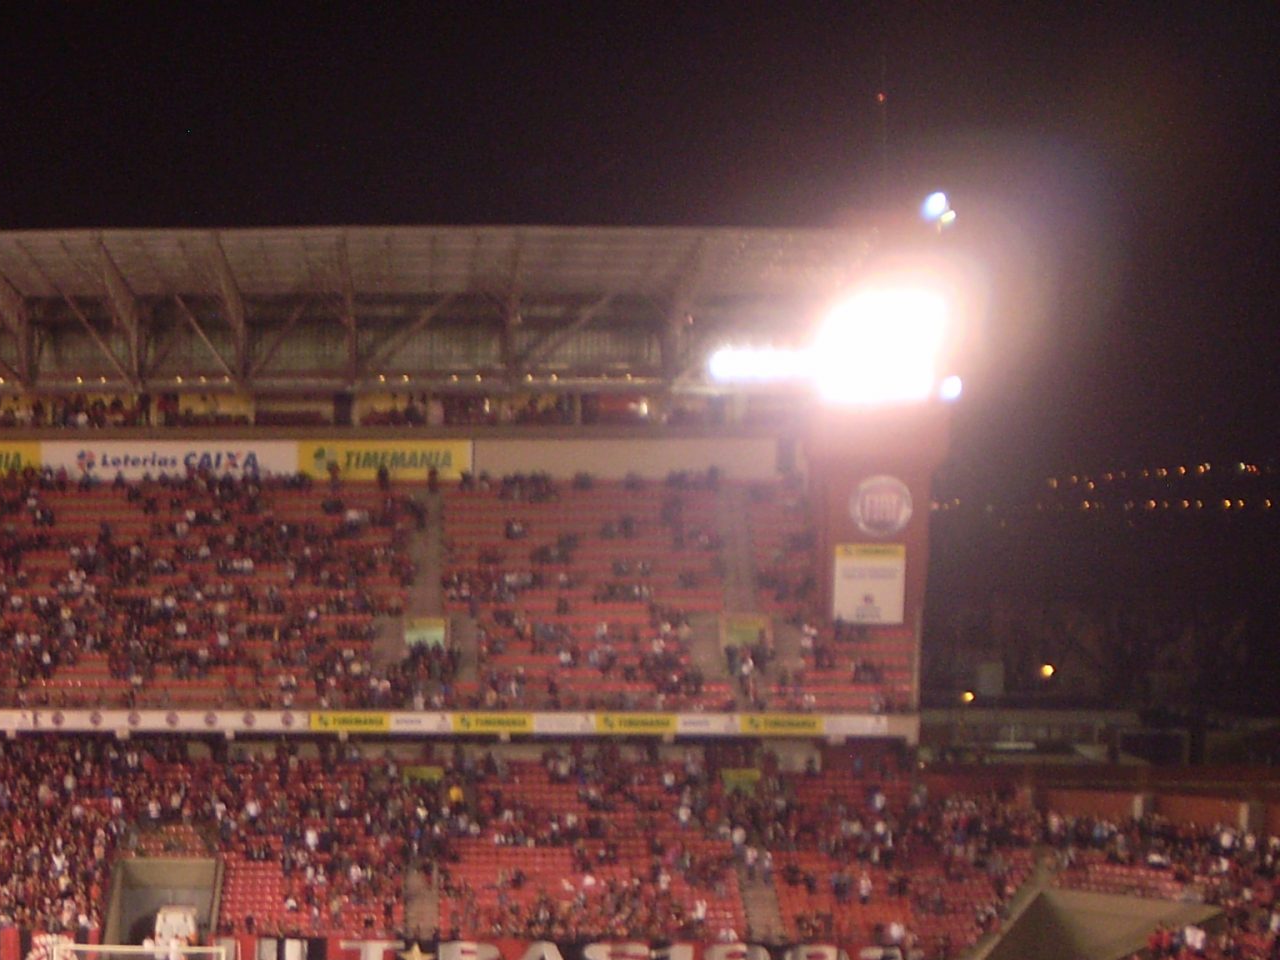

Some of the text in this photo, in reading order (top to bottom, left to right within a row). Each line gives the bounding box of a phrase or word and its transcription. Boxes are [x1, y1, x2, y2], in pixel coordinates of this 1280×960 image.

[101, 452, 260, 469] Loterias CAIXA
[345, 450, 453, 469] TIMEMANIA
